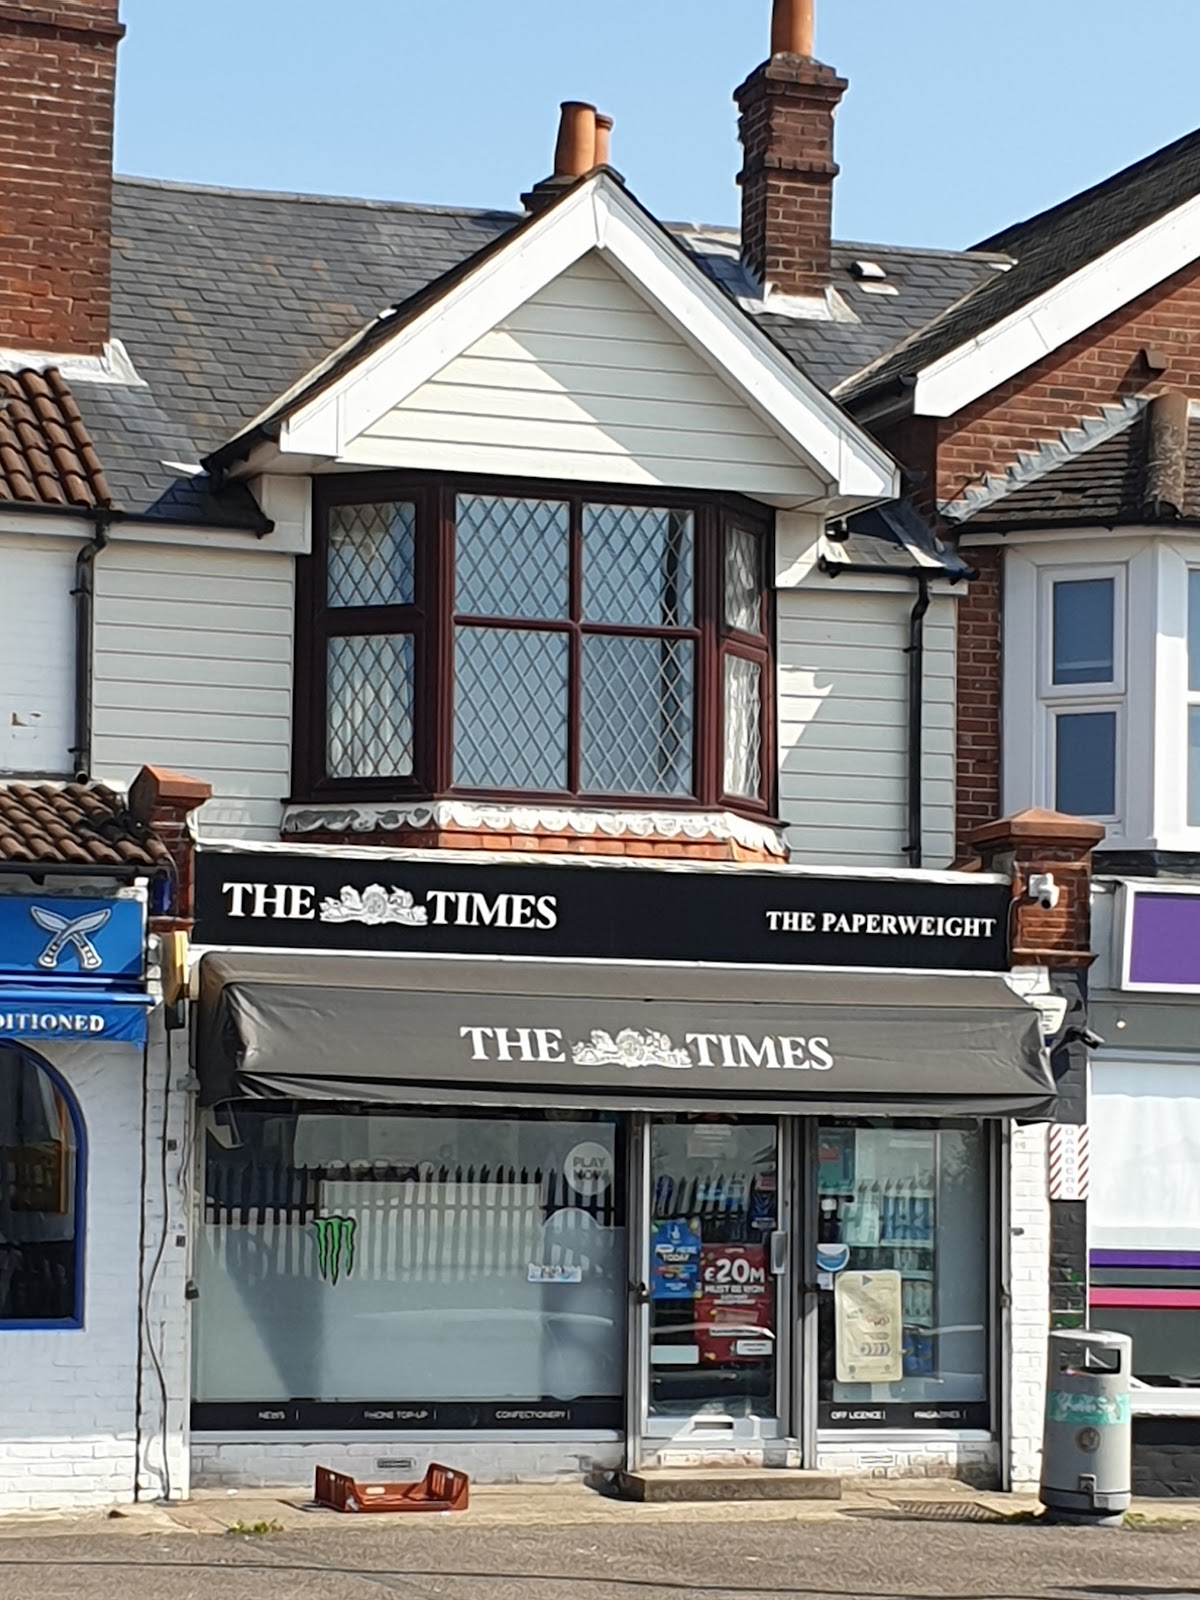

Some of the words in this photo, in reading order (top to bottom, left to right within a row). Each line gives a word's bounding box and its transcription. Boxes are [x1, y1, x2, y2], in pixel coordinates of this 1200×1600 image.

[222, 882, 316, 920] THE
[426, 890, 558, 930] TIMES
[766, 910, 816, 932] THE
[821, 912, 997, 939] PAPERWEIGHT
[459, 1026, 566, 1064] THE
[686, 1032, 835, 1071] TIMES
[573, 1156, 606, 1168] PLAY
[704, 1284, 730, 1294] MUST
